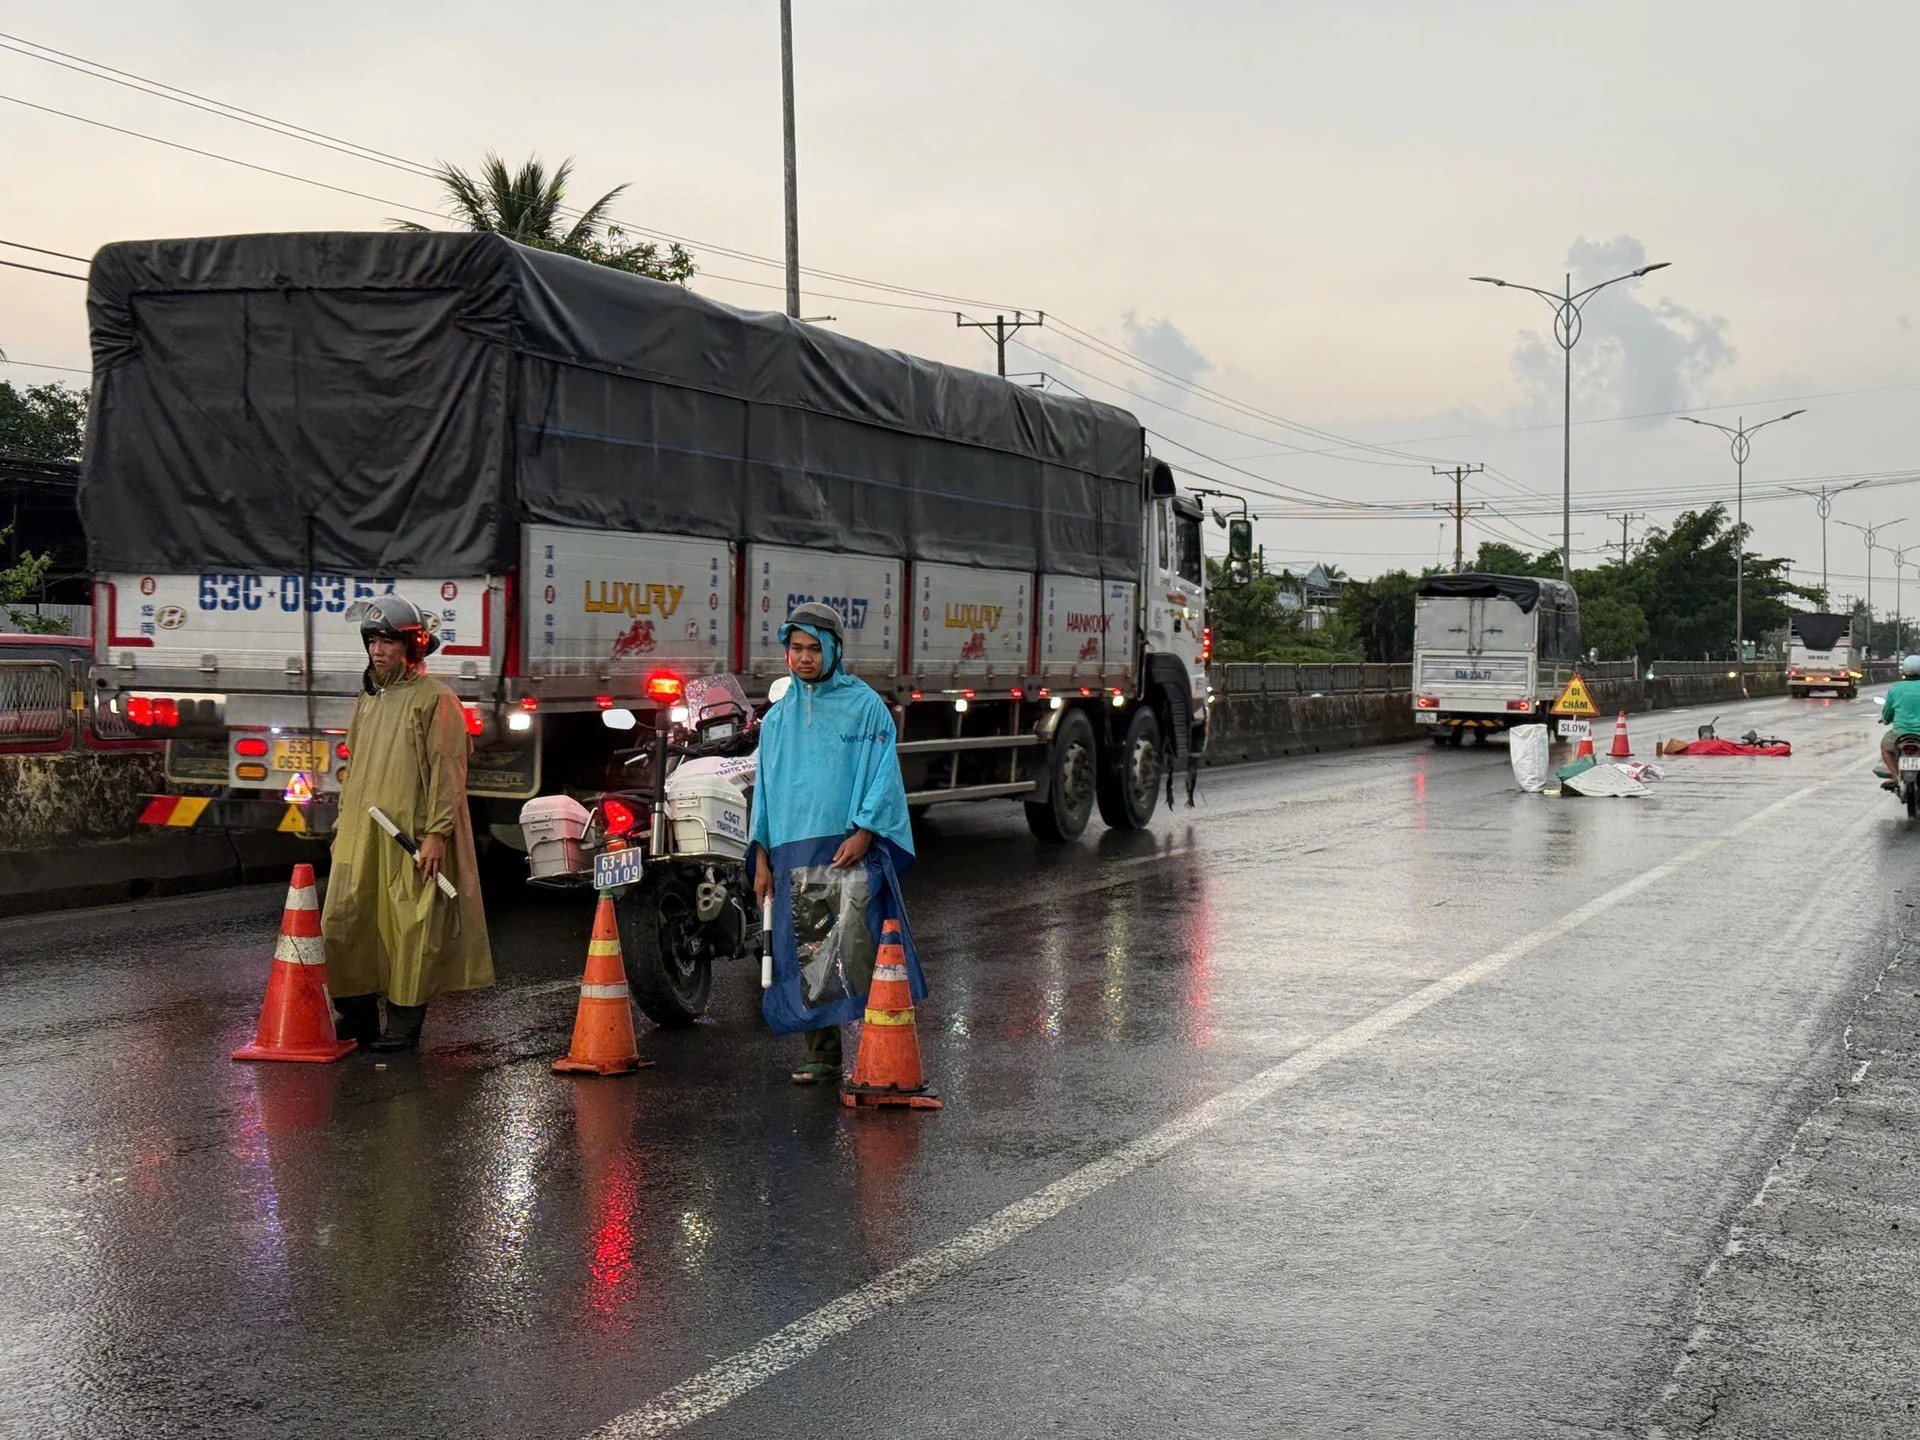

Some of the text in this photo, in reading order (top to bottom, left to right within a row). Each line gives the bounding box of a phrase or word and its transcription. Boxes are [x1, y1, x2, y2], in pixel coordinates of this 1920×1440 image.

[584, 579, 685, 620] LUXURY
[1560, 723, 1588, 733] SLOW
[723, 810, 741, 826] CSGT
[601, 851, 634, 871] 63-A1
[597, 865, 639, 887] 001.09
